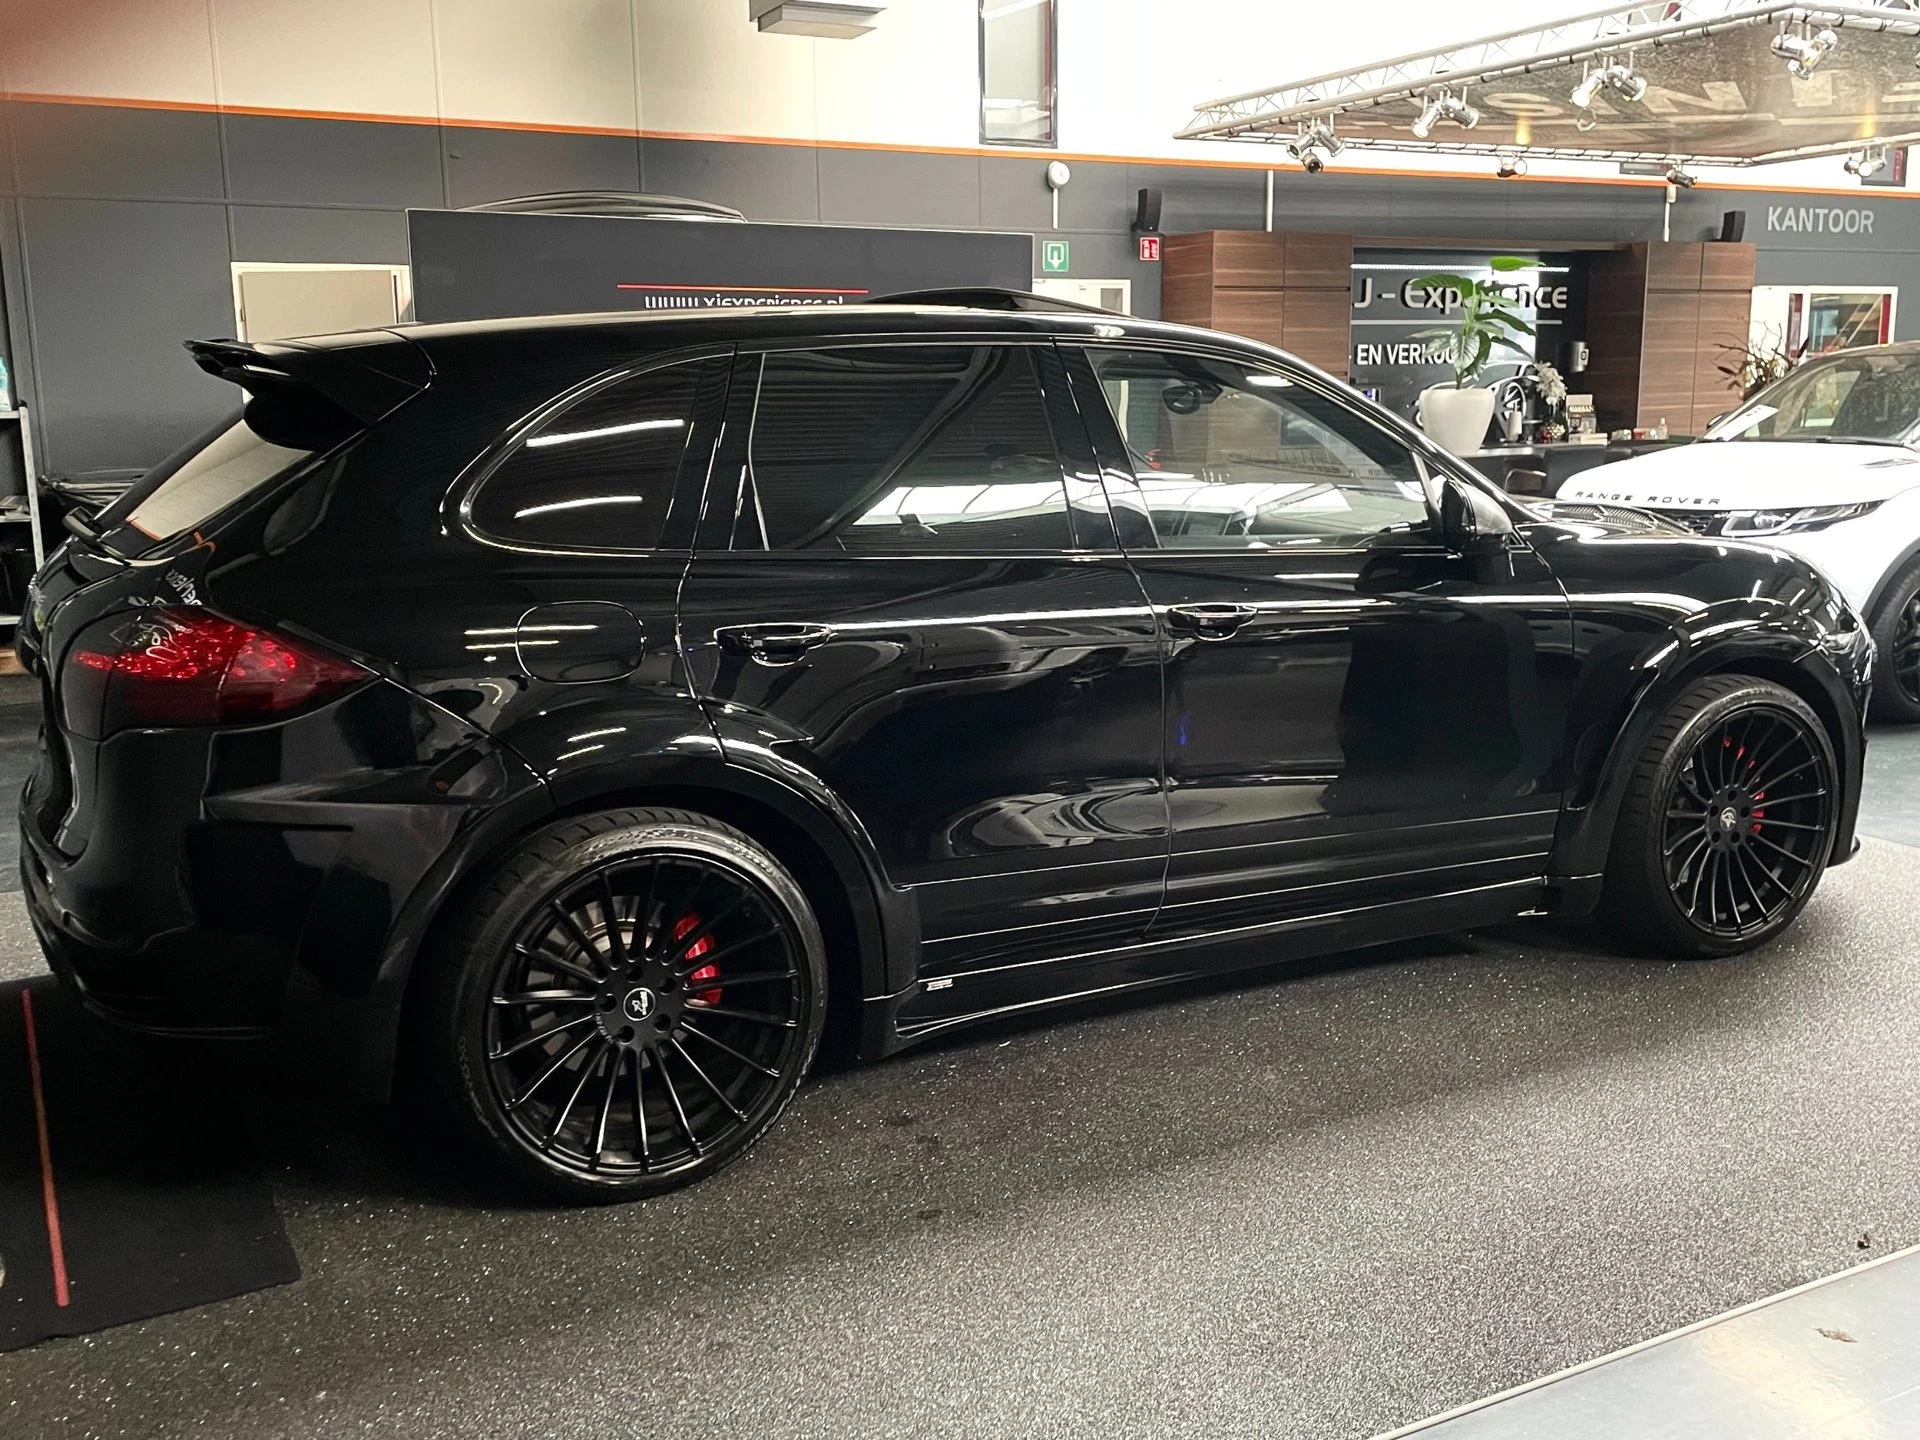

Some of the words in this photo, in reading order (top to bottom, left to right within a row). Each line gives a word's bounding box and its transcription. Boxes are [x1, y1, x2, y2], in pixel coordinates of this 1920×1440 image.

[1767, 206, 1875, 234] KANTOOR
[1354, 277, 1373, 308] J
[1356, 343, 1383, 366] EN
[1574, 491, 1635, 502] RANGE
[1646, 496, 1722, 505] ROVER
